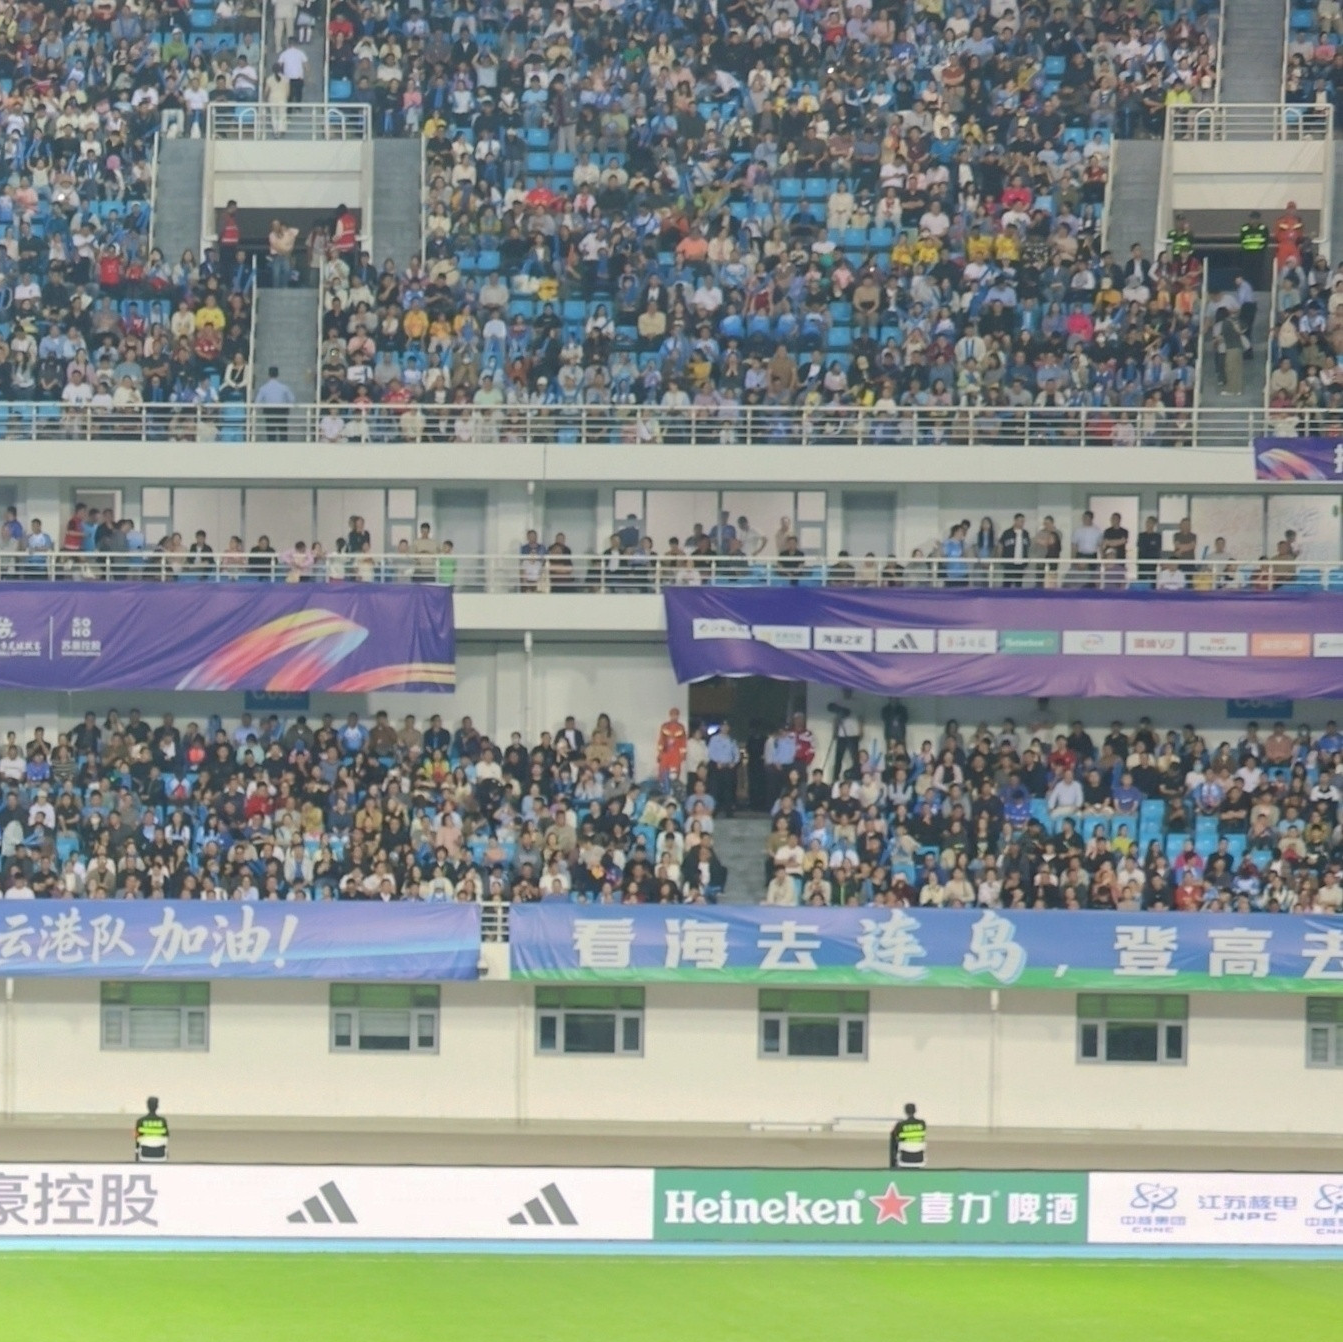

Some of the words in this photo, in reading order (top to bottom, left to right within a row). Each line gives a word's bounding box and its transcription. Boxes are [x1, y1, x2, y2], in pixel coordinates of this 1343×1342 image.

[664, 1181, 865, 1226] Heineken
[1198, 1194, 1298, 1211] 江苏核电
[1213, 1211, 1279, 1222] JNPC
